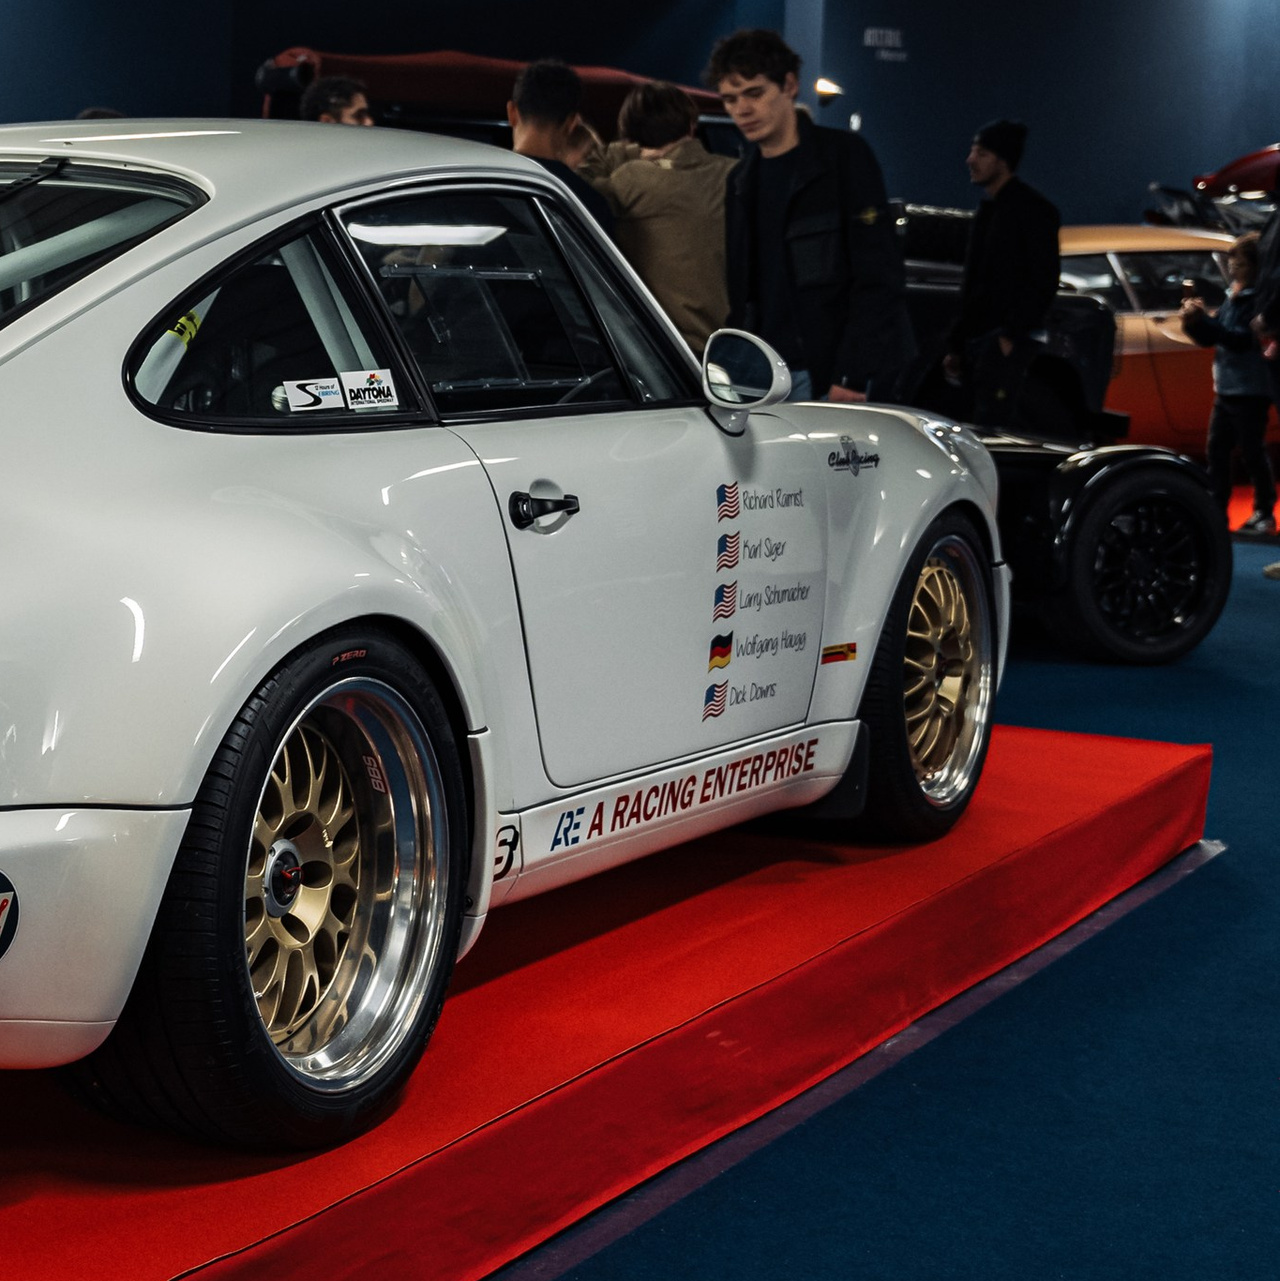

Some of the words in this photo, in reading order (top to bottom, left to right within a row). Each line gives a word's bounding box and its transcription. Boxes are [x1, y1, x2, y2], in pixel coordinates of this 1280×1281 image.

[348, 386, 393, 401] DAYTONA
[742, 489, 775, 510] Richard
[742, 539, 762, 560] Karl
[739, 589, 762, 612] Larry
[764, 582, 810, 606] Schumacher
[340, 650, 367, 662] ZERO
[736, 633, 778, 659] Wolfgang
[729, 685, 747, 706] Dick
[749, 682, 777, 702] Downs
[362, 755, 385, 793] BBS
[586, 802, 605, 840] A
[610, 775, 697, 832] RACING
[699, 738, 818, 805] ENTERPRISE
